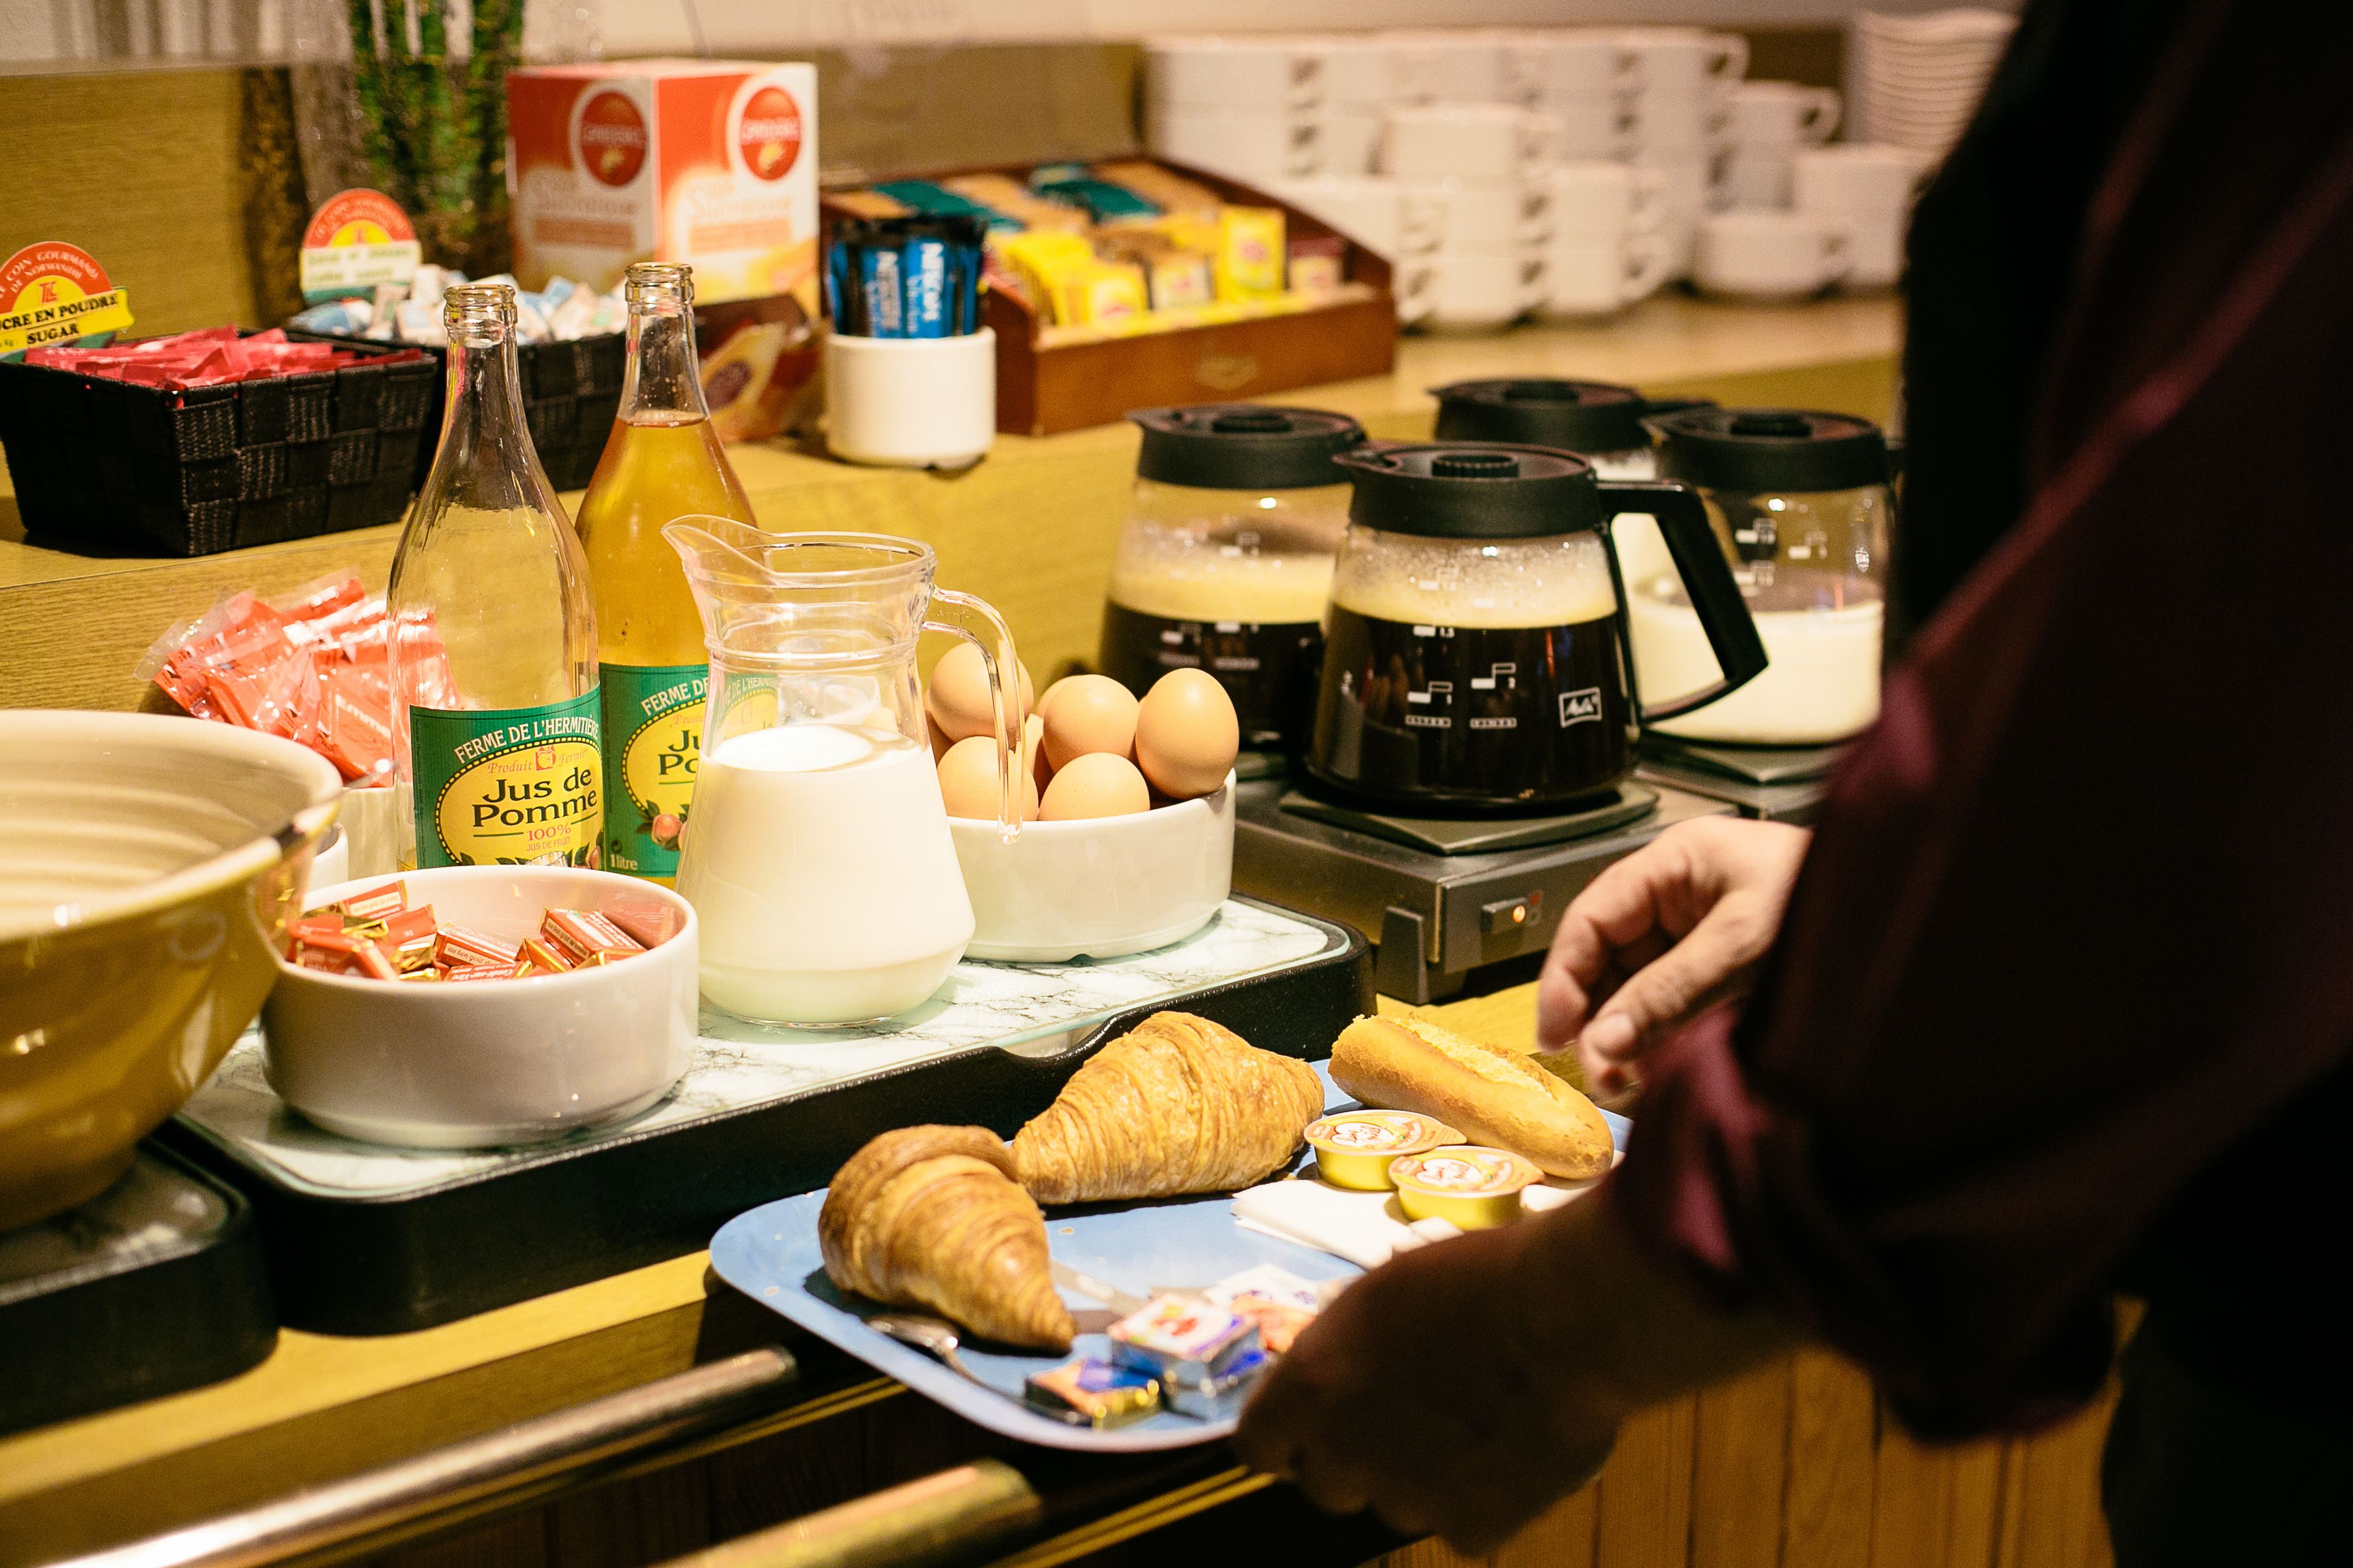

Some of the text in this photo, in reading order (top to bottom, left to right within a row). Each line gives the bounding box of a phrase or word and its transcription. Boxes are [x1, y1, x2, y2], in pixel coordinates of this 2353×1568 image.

[6, 258, 32, 282] COIN
[10, 279, 24, 294] DE
[0, 294, 118, 331] CRE EN POUDRE
[27, 322, 79, 345] SUGAR
[641, 683, 692, 716] FERME
[453, 714, 599, 764] FERME DE L'HERMITIÈRE
[668, 729, 700, 752] Ju
[488, 747, 589, 775] Produit Fermier
[482, 766, 592, 803] Jus de
[472, 789, 598, 828] Pomme
[526, 823, 571, 841] 100%
[526, 836, 571, 852] JUS DE FRUIT
[457, 949, 468, 959] bon
